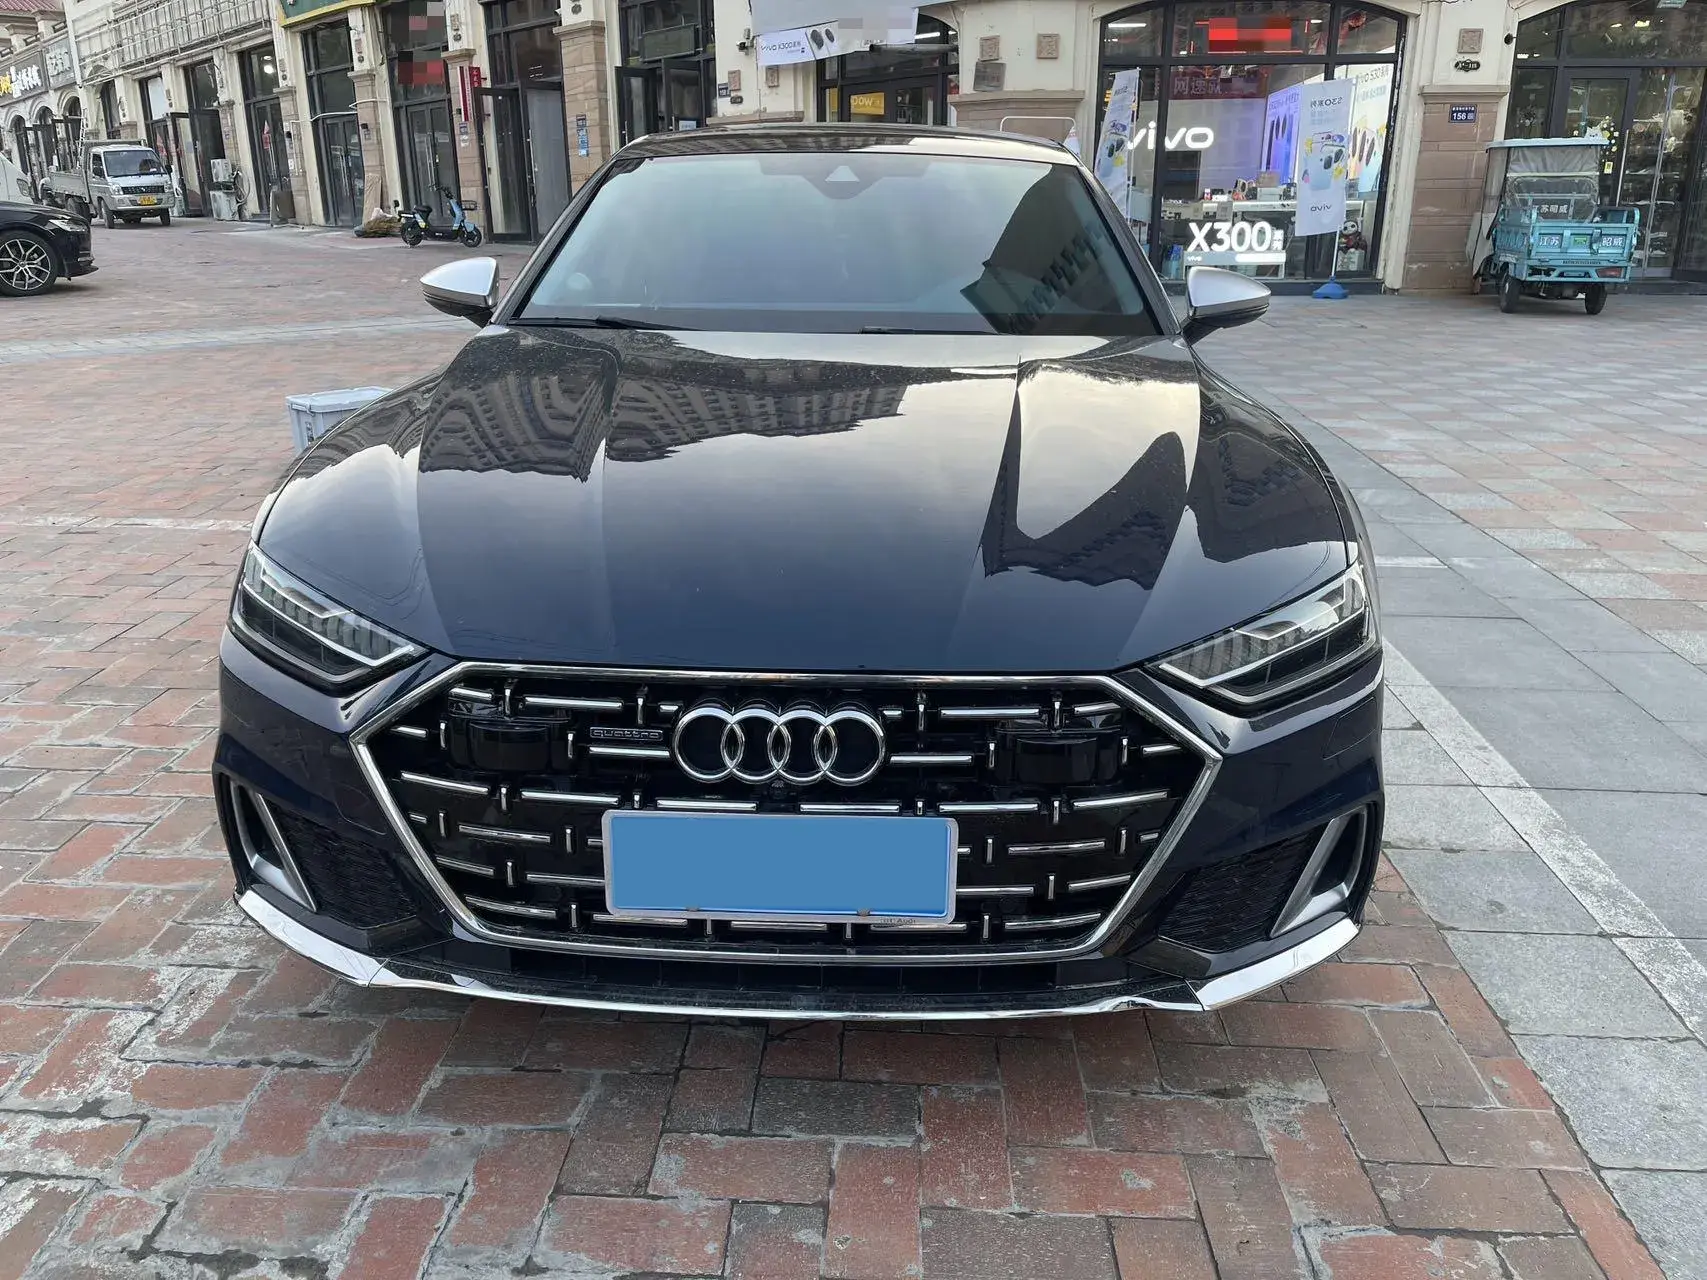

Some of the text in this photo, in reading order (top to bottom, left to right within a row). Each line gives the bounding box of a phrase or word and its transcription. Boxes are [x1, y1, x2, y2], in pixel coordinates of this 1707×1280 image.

[1452, 112, 1466, 120] 156
[1127, 122, 1215, 150] vivo
[1187, 221, 1272, 252] X300
[593, 729, 660, 739] quattro
